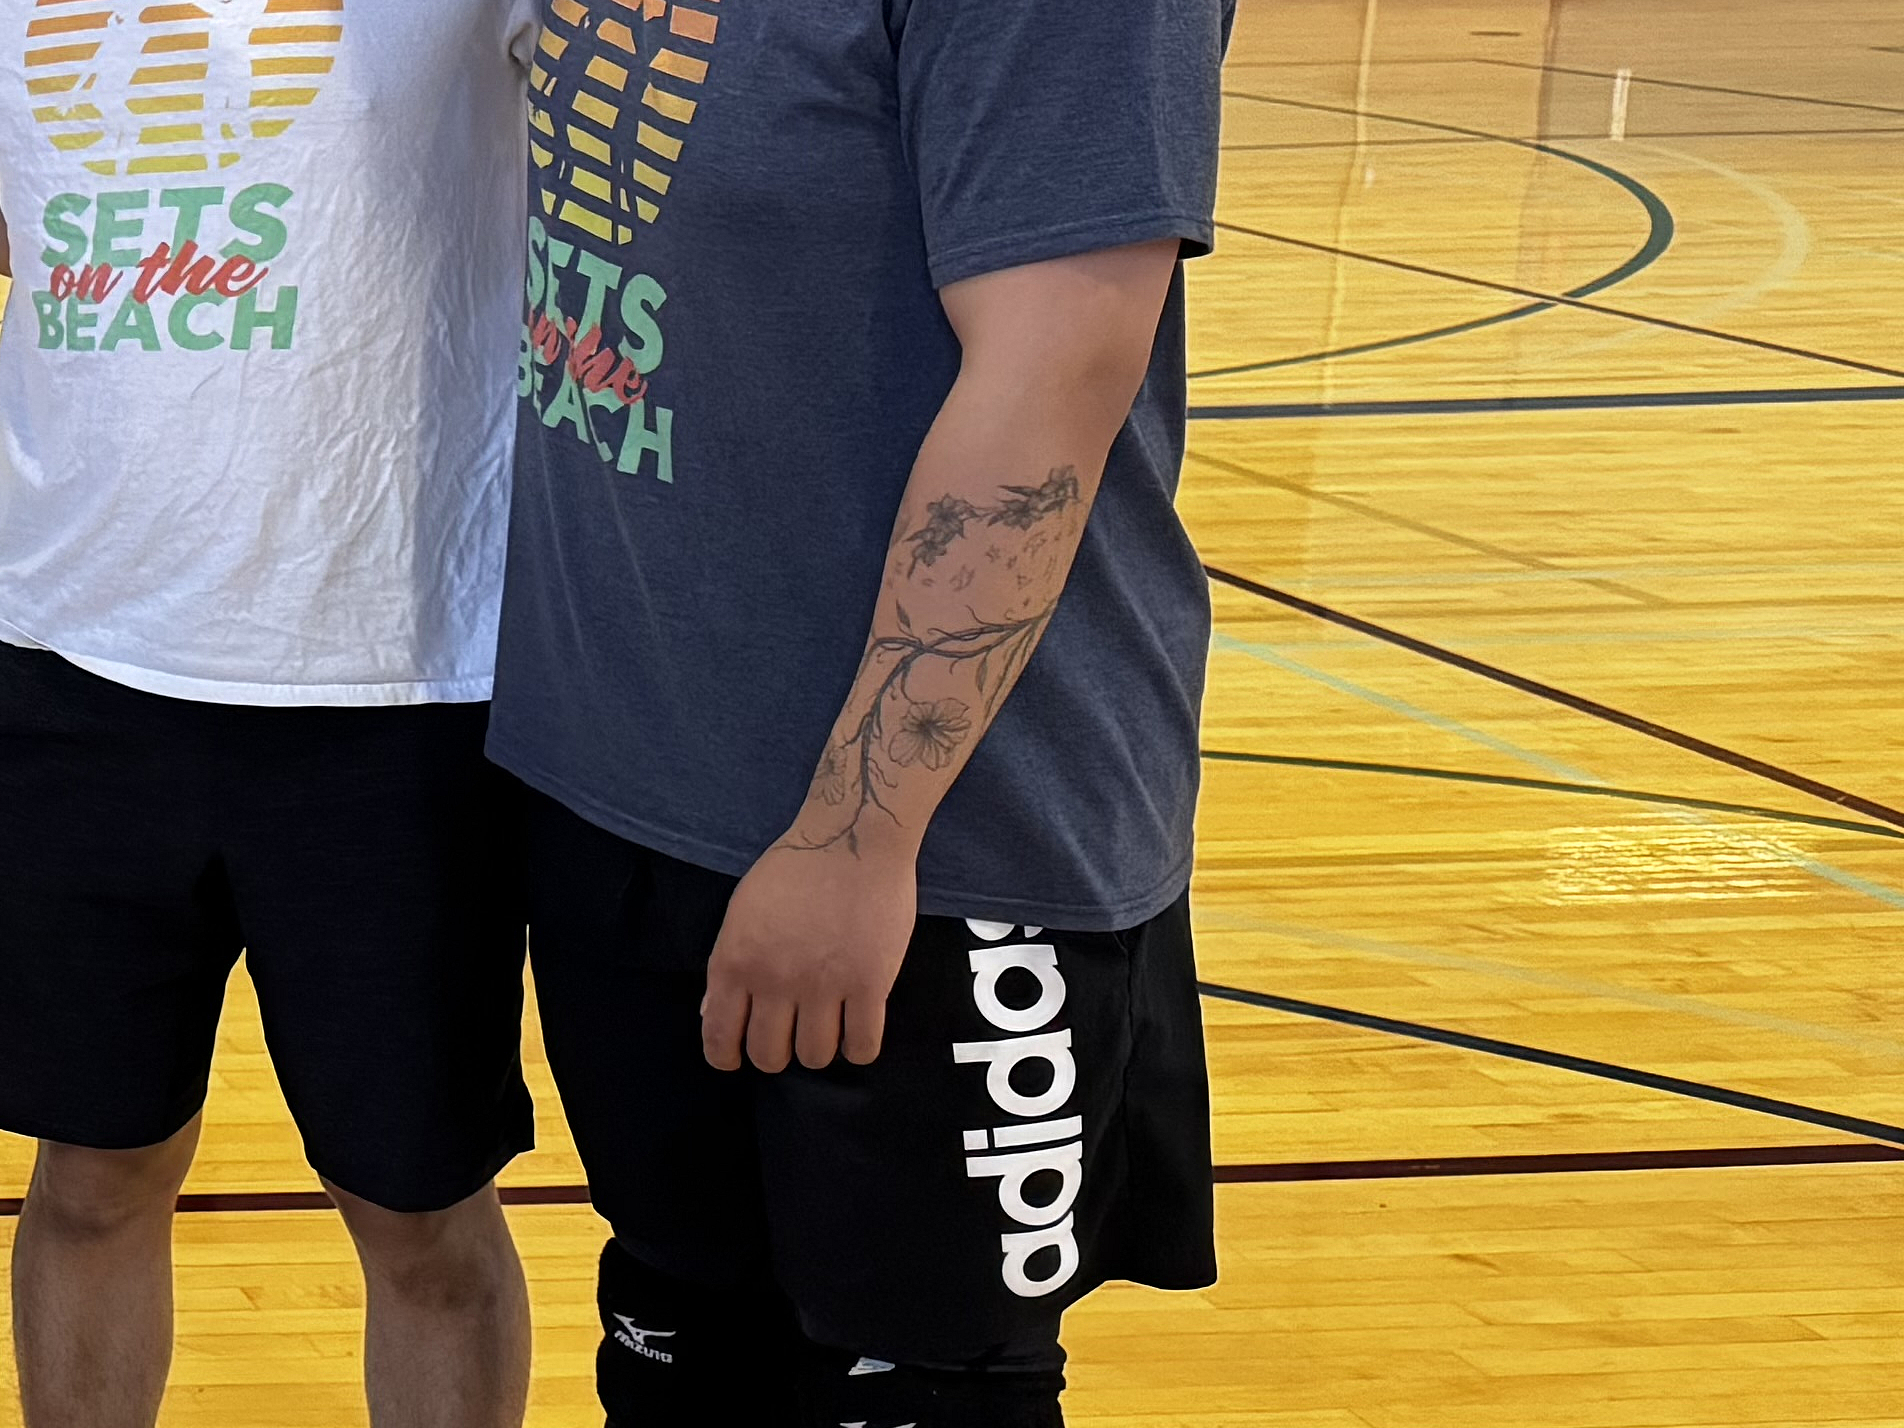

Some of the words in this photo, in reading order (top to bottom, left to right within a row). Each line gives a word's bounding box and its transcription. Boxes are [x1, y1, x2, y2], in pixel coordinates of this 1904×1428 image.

[41, 182, 294, 269] SETS
[50, 262, 125, 304] on
[132, 239, 270, 305] the
[32, 286, 299, 352] BEACH
